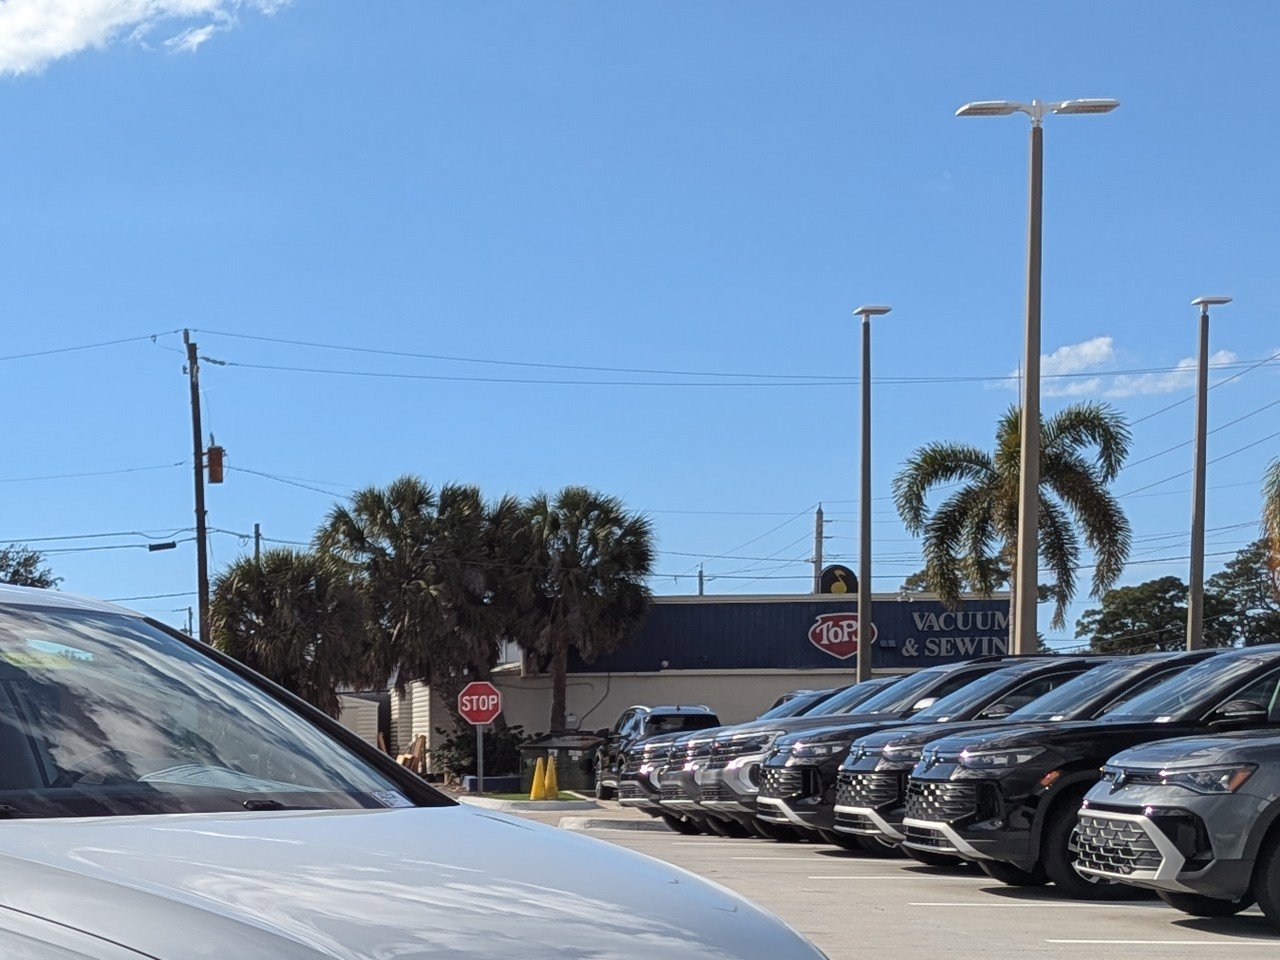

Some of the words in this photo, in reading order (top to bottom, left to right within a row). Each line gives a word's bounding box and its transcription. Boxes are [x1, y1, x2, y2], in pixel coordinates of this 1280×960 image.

[901, 636, 919, 657] &
[924, 636, 1008, 656] SEWIN
[461, 695, 498, 711] STOP
